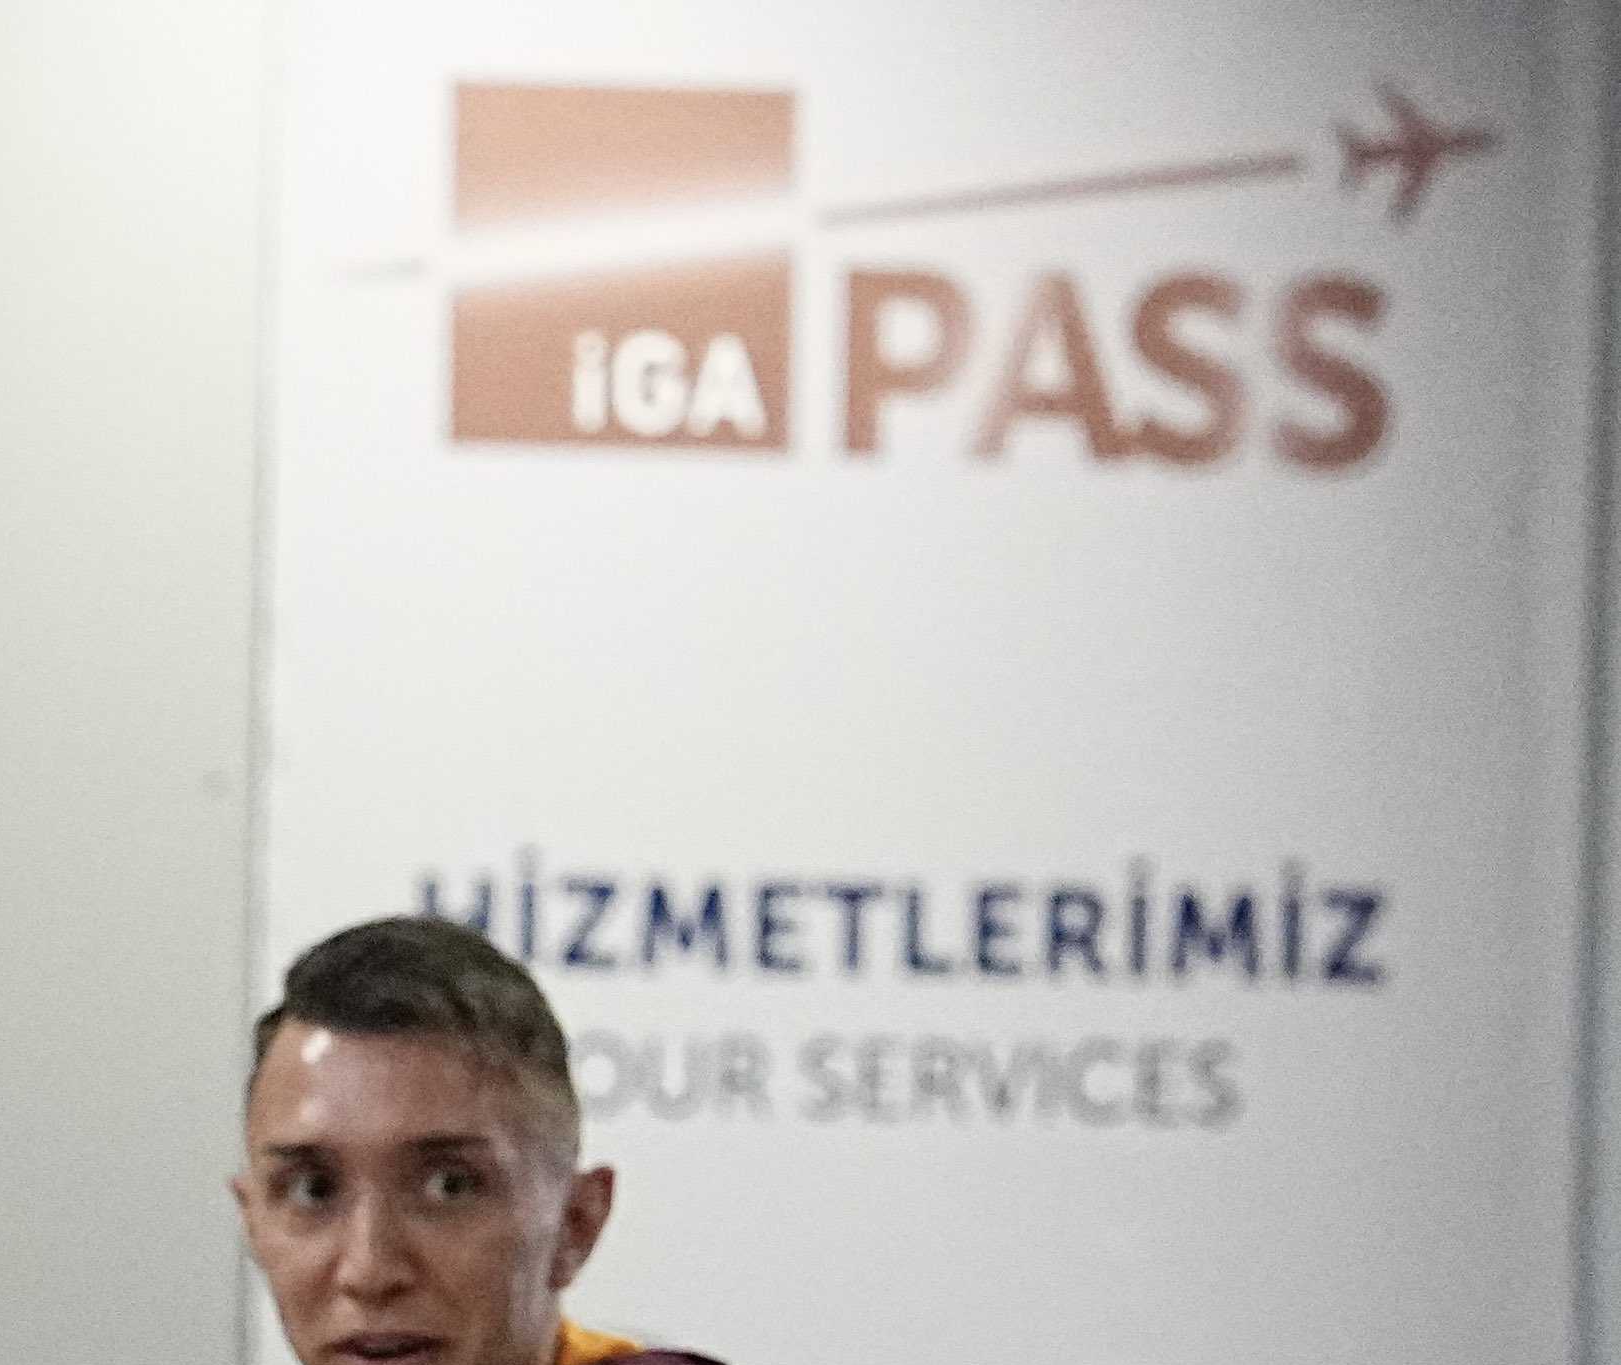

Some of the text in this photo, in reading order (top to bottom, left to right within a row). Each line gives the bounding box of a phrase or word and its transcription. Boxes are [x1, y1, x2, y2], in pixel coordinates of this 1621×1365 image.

[844, 266, 1387, 470] PASS
[574, 1032, 1242, 1128] OUR SERVICES
